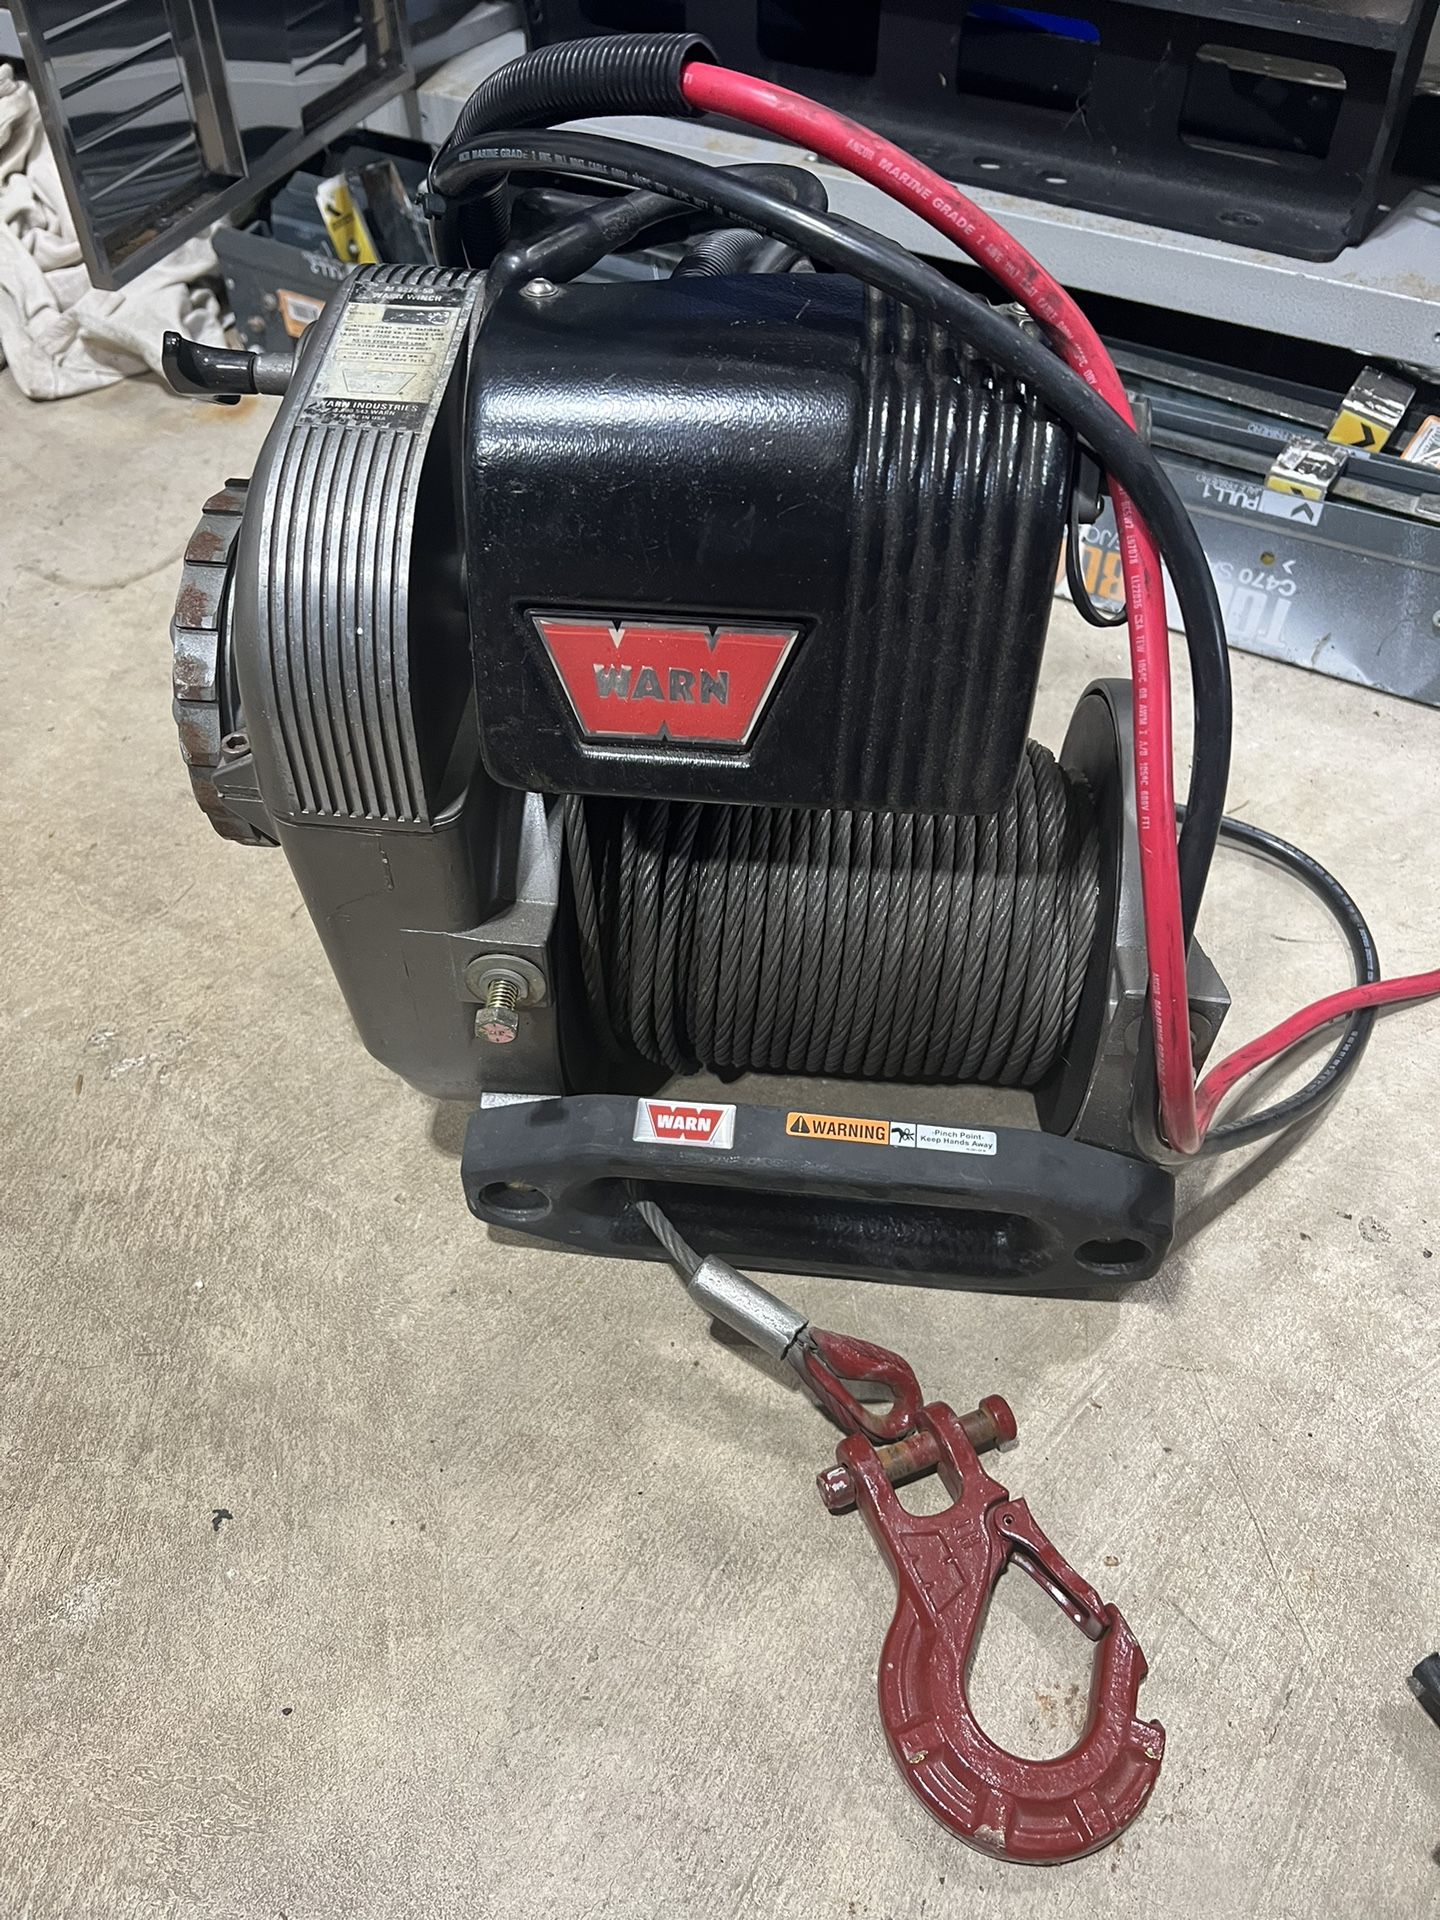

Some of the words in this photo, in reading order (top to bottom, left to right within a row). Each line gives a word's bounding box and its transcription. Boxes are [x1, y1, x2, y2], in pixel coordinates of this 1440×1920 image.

[472, 149, 499, 158] MARINE
[500, 149, 528, 158] GRADE
[878, 158, 932, 200] MARINE
[932, 197, 976, 235] GRADE
[406, 294, 442, 302] WINCH
[320, 400, 349, 408] WARN
[353, 401, 419, 412] INDUSTRIES
[1202, 484, 1211, 498] 1
[1213, 482, 1259, 511] PULL
[1239, 568, 1296, 596] C470
[1136, 634, 1145, 652] TEW
[593, 663, 729, 705] WARN
[1139, 704, 1148, 725] AWM
[657, 1114, 711, 1132] WARN
[812, 1120, 885, 1141] WARNING
[921, 1135, 942, 1144] Keep
[943, 1138, 969, 1146] Hands
[972, 1140, 993, 1149] Away
